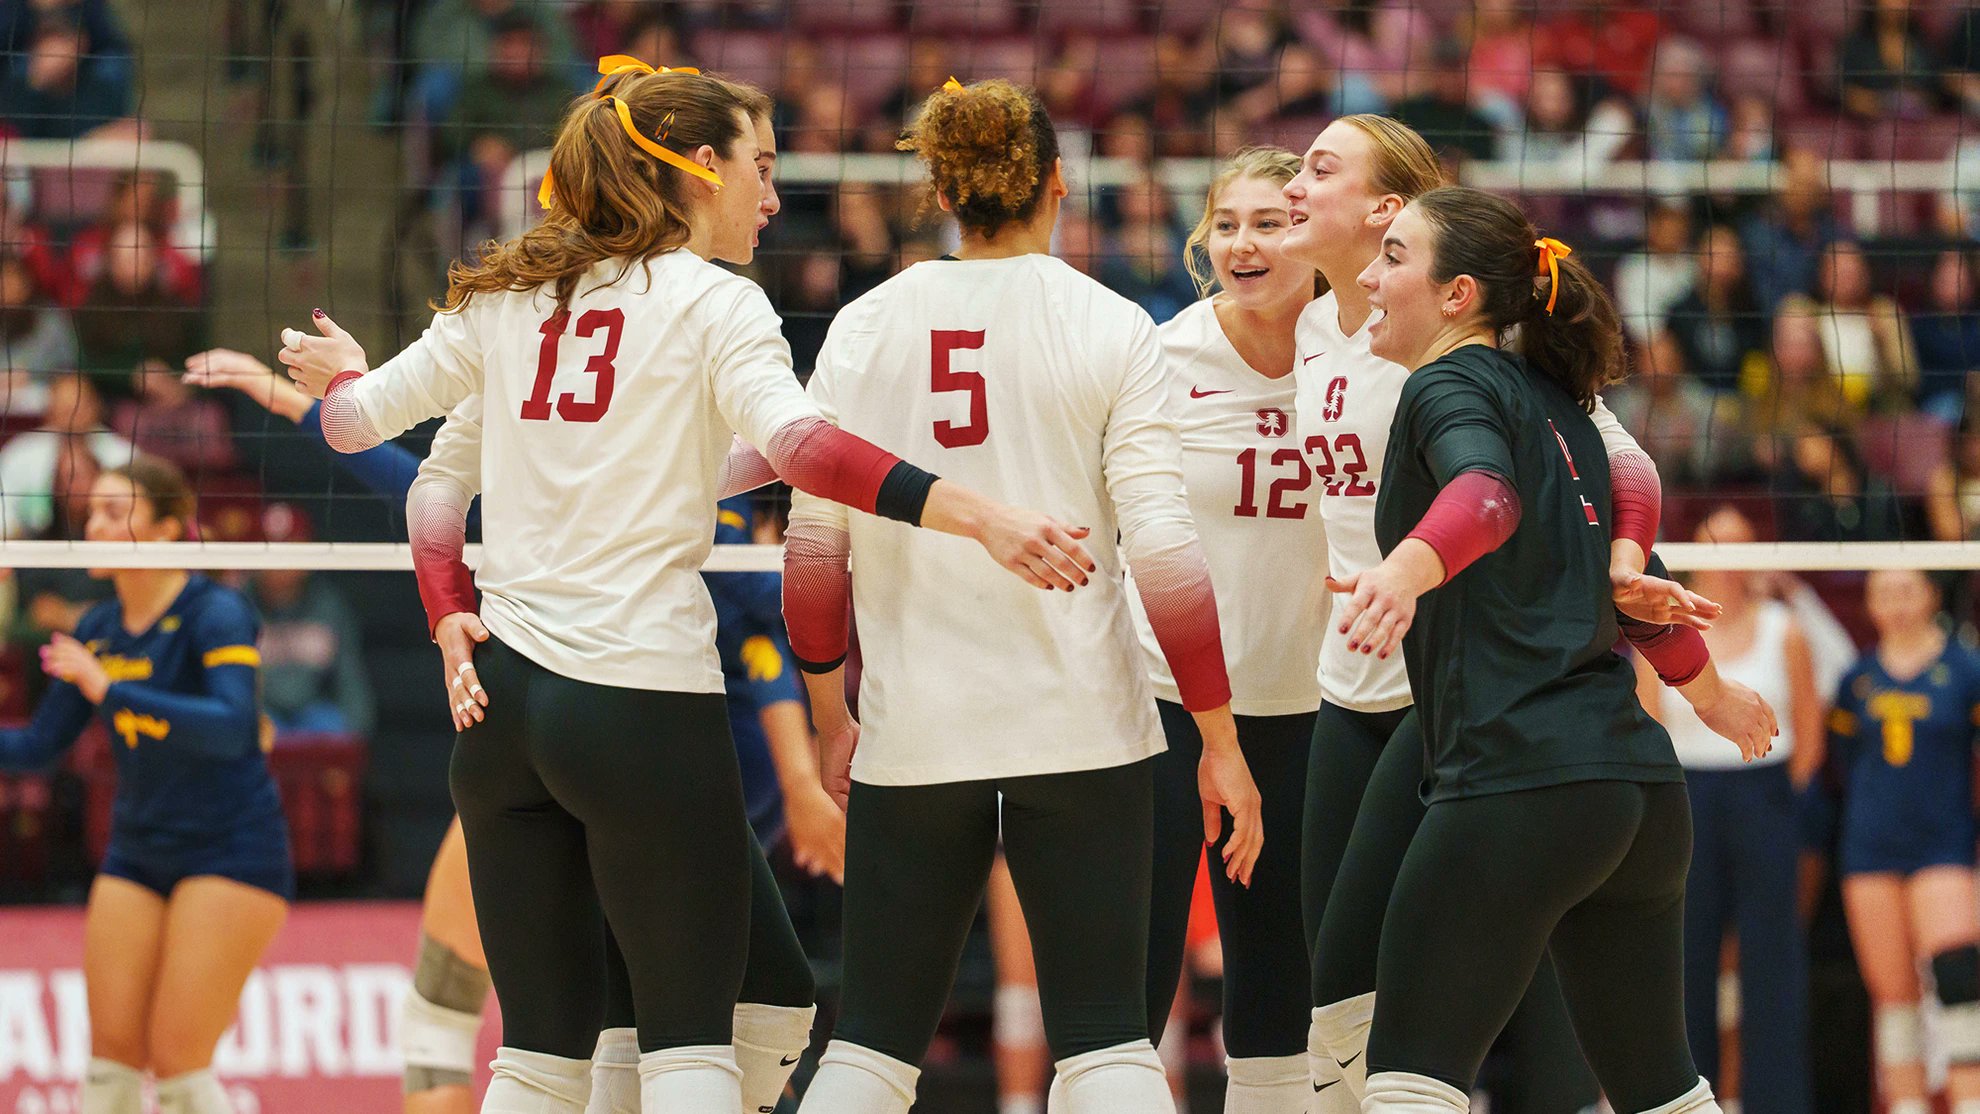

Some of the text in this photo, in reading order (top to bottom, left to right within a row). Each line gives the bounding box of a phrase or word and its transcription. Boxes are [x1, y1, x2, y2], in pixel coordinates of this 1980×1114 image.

[520, 307, 625, 423] 13
[930, 328, 989, 449] 5
[1234, 447, 1312, 520] 12
[1304, 433, 1376, 497] 22
